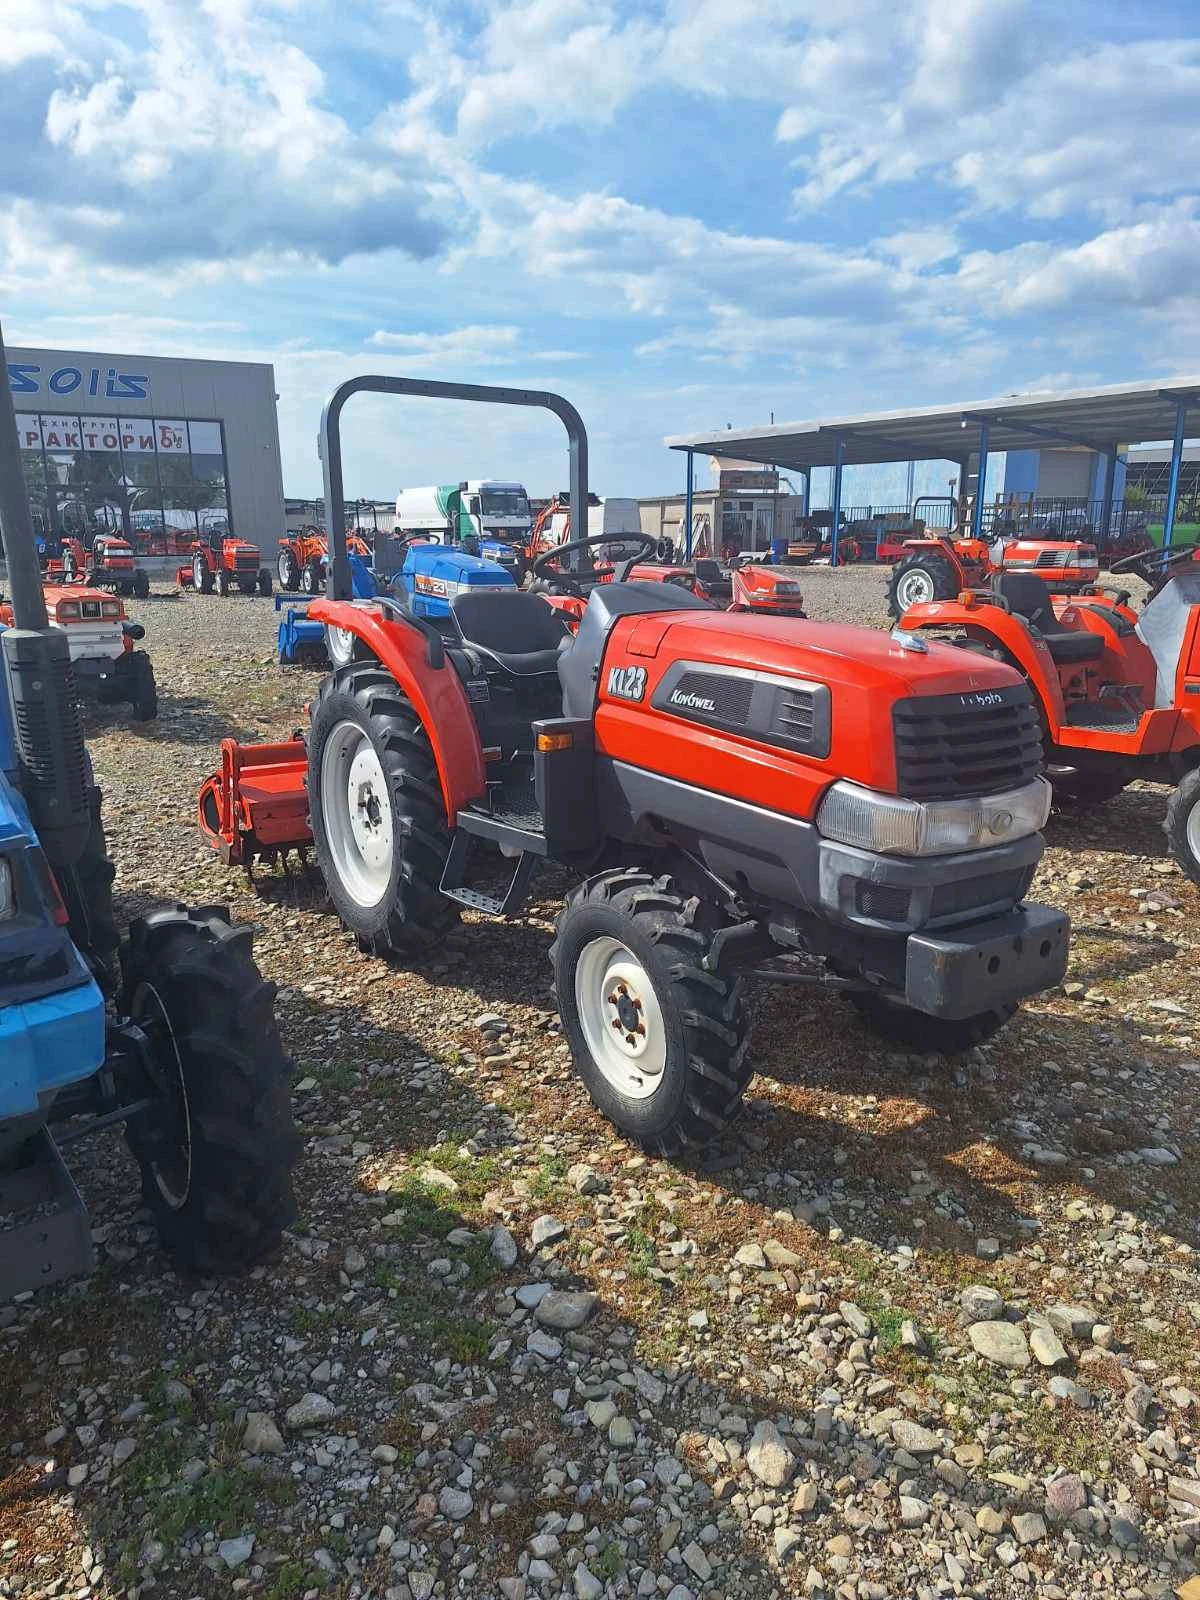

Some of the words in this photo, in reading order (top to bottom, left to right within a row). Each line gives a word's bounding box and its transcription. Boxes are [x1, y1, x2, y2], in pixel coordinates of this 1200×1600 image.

[18, 431, 153, 449] РАКТОРИ
[433, 582, 445, 593] 23
[608, 666, 646, 699] KL23
